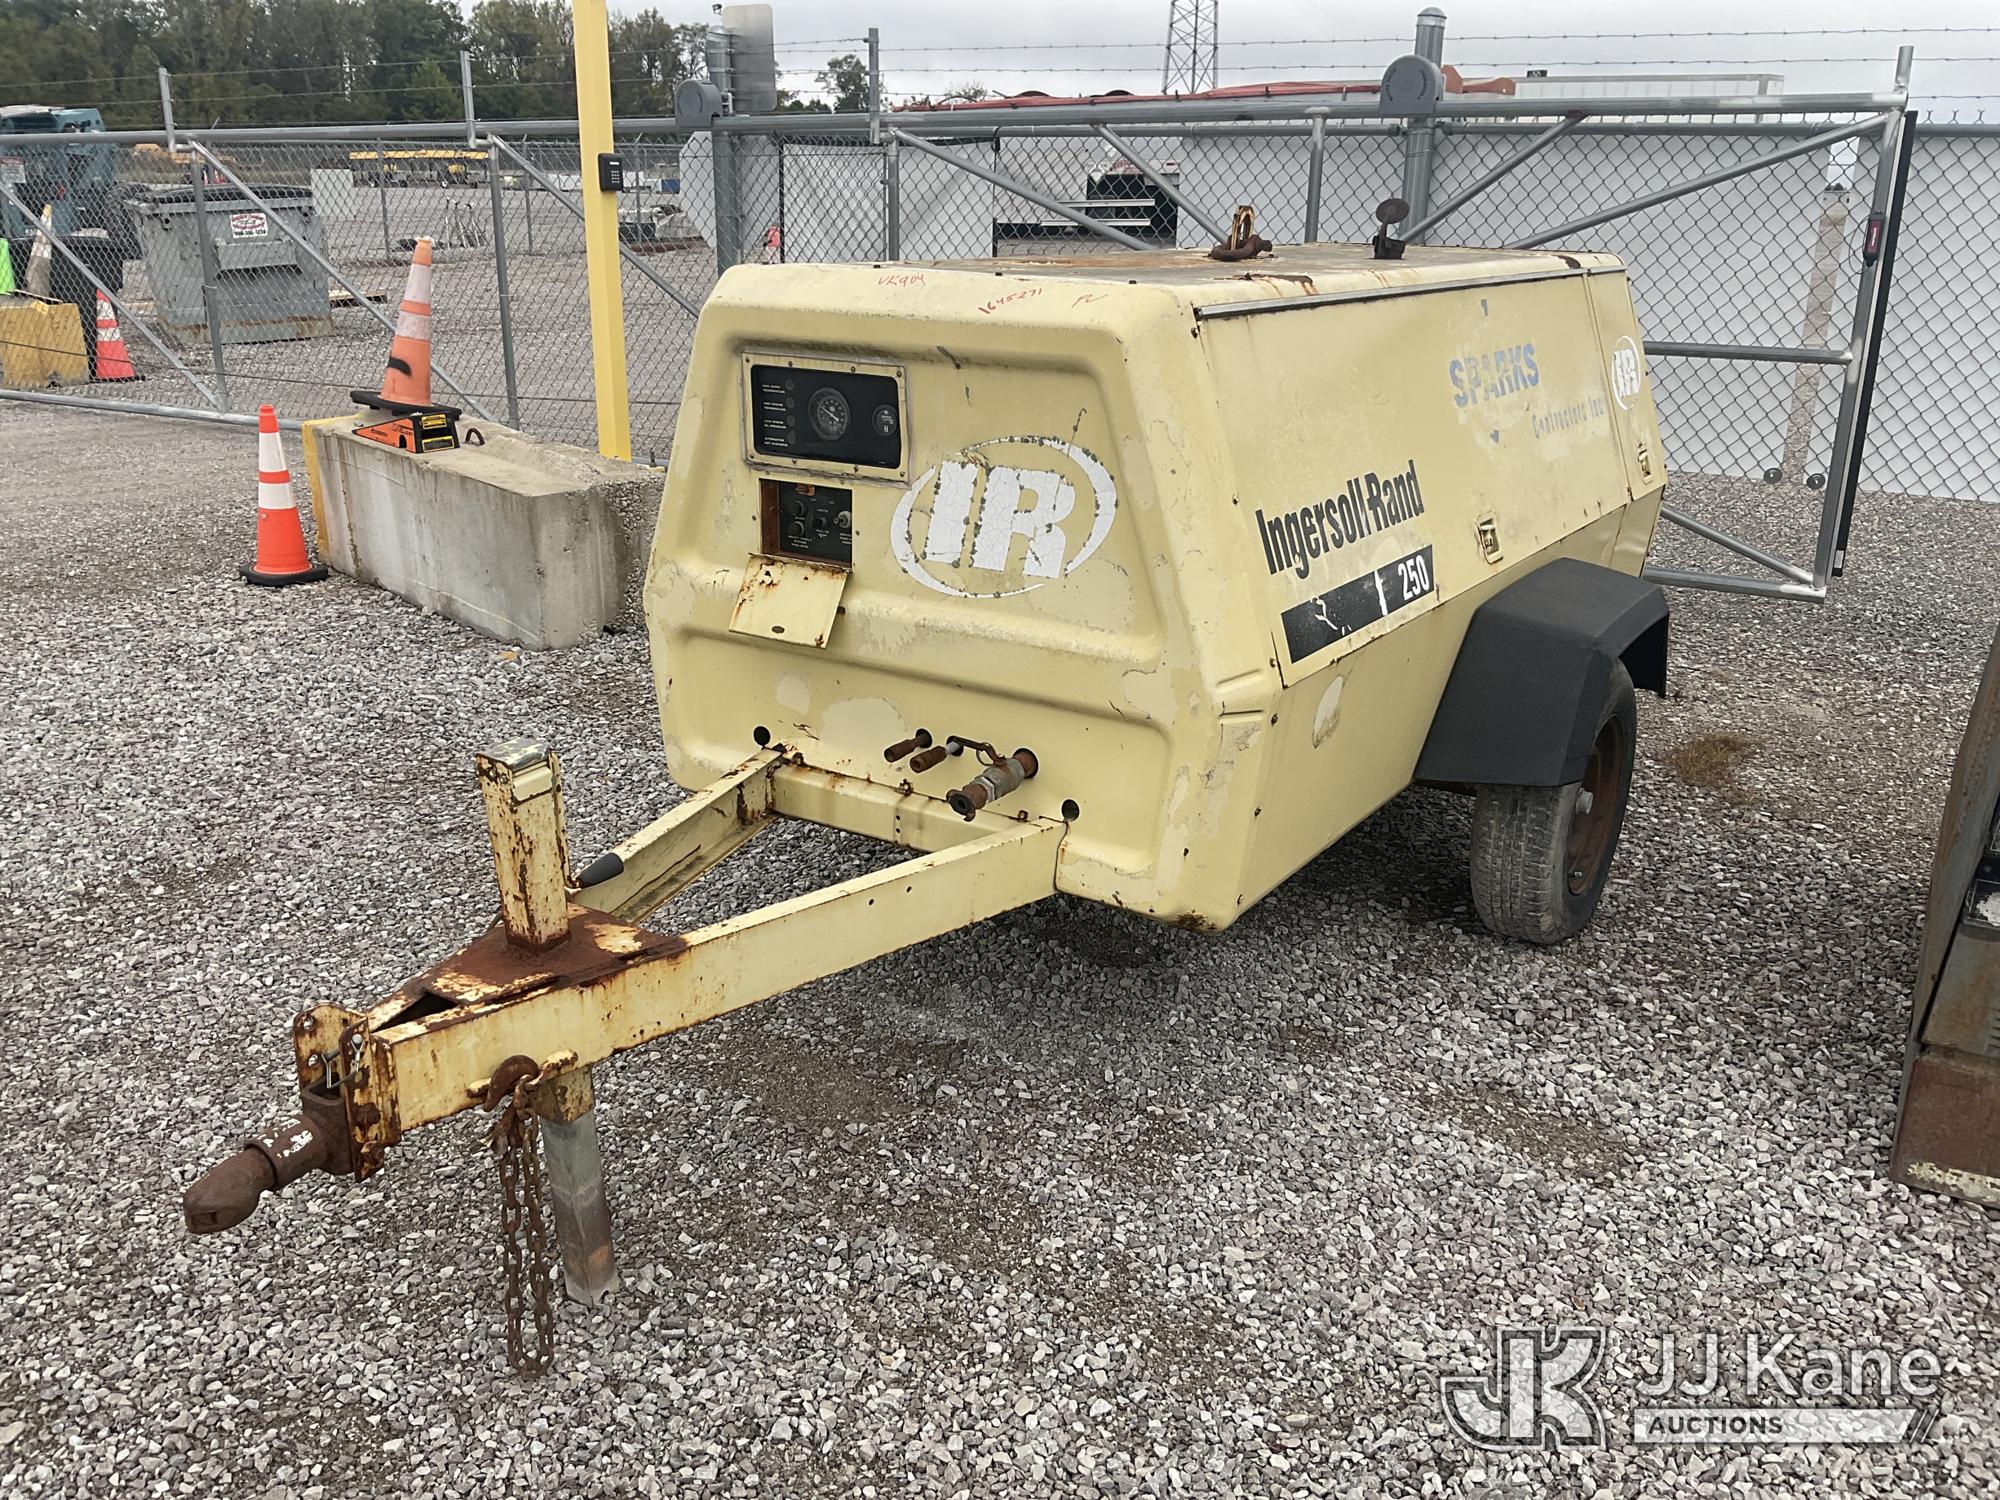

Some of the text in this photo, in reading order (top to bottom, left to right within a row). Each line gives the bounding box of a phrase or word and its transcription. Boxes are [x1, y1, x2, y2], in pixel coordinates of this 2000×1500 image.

[978, 288, 1043, 315] 1645271
[1449, 343, 1540, 408] SPARKS
[924, 460, 1076, 580] IR
[1397, 554, 1430, 601] 250
